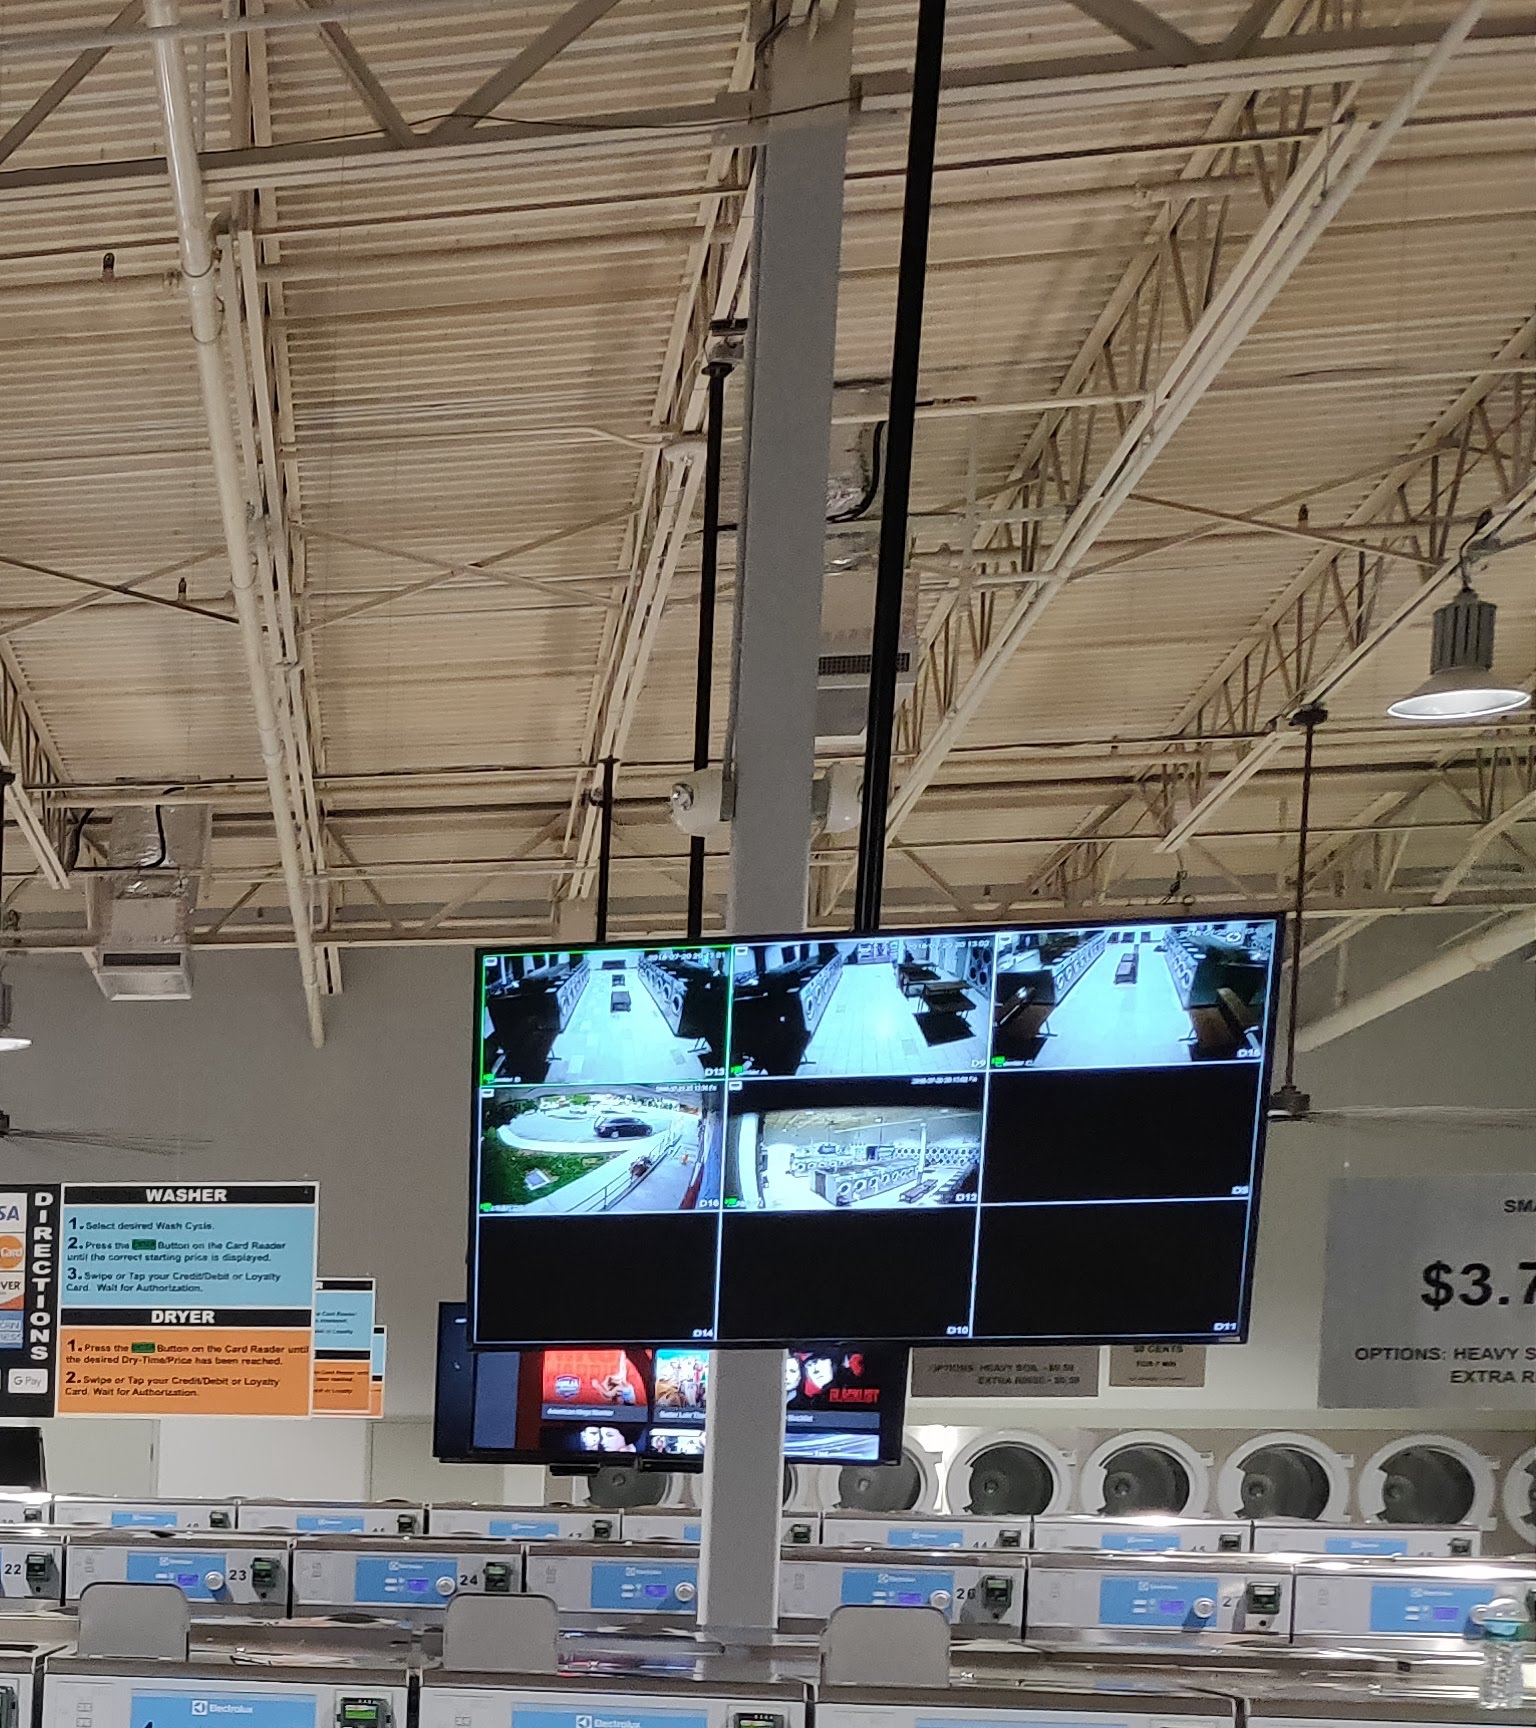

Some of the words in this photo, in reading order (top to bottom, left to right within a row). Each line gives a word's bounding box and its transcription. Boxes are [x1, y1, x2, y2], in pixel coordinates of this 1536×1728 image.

[146, 1188, 228, 1202] WASHER
[68, 1216, 84, 1230] 1.
[86, 1221, 115, 1230] Select
[117, 1221, 153, 1230] desired
[156, 1221, 182, 1230] Wash
[67, 1237, 83, 1250] 2.
[85, 1241, 112, 1250] Press
[158, 1241, 190, 1250] Button
[192, 1242, 205, 1250] on
[208, 1241, 223, 1250] the
[225, 1241, 249, 1250] Card
[252, 1241, 286, 1250] Reader
[91, 1252, 106, 1262] the
[108, 1252, 142, 1262] correct
[144, 1252, 181, 1263] starting
[184, 1253, 208, 1264] price
[211, 1253, 219, 1262] is
[222, 1252, 271, 1264] displayed.
[28, 1192, 54, 1360] DIRECTIONS
[67, 1267, 82, 1280] 3.
[85, 1271, 113, 1282] Swipe
[115, 1273, 126, 1281] or
[129, 1271, 145, 1283] Tap
[148, 1273, 170, 1283] your
[232, 1273, 242, 1281] or
[245, 1272, 281, 1283] Loyalty
[97, 1283, 118, 1292] Wait
[120, 1283, 134, 1292] for
[136, 1283, 203, 1292] Authorization.
[151, 1310, 215, 1324] DRYER
[947, 1325, 969, 1335] D10
[1213, 1321, 1237, 1331] D11
[692, 1328, 714, 1338] D14
[67, 1339, 83, 1352] 1.
[84, 1343, 111, 1352] Press
[114, 1343, 129, 1352] the
[157, 1344, 189, 1353] Button
[191, 1345, 204, 1353] on
[207, 1344, 222, 1353] the
[224, 1344, 248, 1353] Card
[250, 1344, 285, 1354] Reader
[288, 1344, 310, 1354] until
[1355, 1347, 1447, 1361] OPTIONS:
[1454, 1347, 1519, 1361] HEAVY
[66, 1355, 81, 1364] the
[83, 1355, 119, 1364] desired
[195, 1356, 212, 1365] has
[215, 1356, 239, 1365] been
[241, 1356, 283, 1366] reached.
[25, 1376, 42, 1387] Pay
[65, 1371, 81, 1384] 2.
[83, 1376, 112, 1386] Swipe
[114, 1377, 125, 1385] or
[128, 1376, 145, 1387] Tap
[147, 1378, 169, 1387] your
[231, 1378, 242, 1386] or
[244, 1377, 280, 1388] Loyalty
[1450, 1370, 1515, 1384] EXTRA
[93, 1387, 115, 1396] Wait
[117, 1387, 130, 1396] for
[132, 1388, 199, 1397] Authorization.
[5, 1563, 22, 1575] 22
[229, 1569, 247, 1581] 23
[460, 1574, 478, 1586] 24
[209, 1703, 254, 1715] Electrolux
